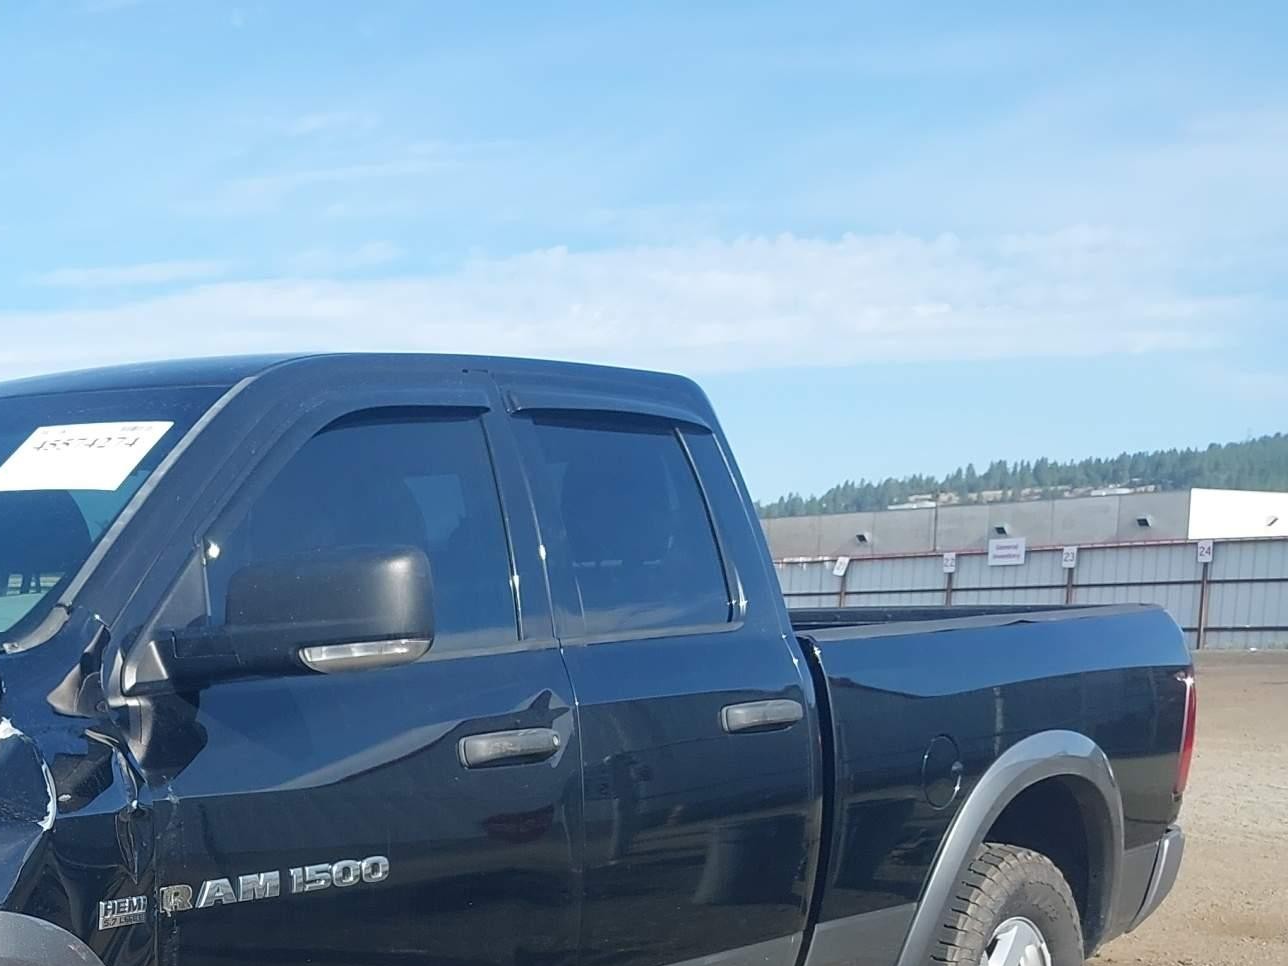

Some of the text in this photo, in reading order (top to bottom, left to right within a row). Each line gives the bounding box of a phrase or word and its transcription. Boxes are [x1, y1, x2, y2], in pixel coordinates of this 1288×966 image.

[1199, 545, 1211, 556] 24
[159, 855, 390, 913] RAM 1500
[100, 896, 148, 919] HEMI
